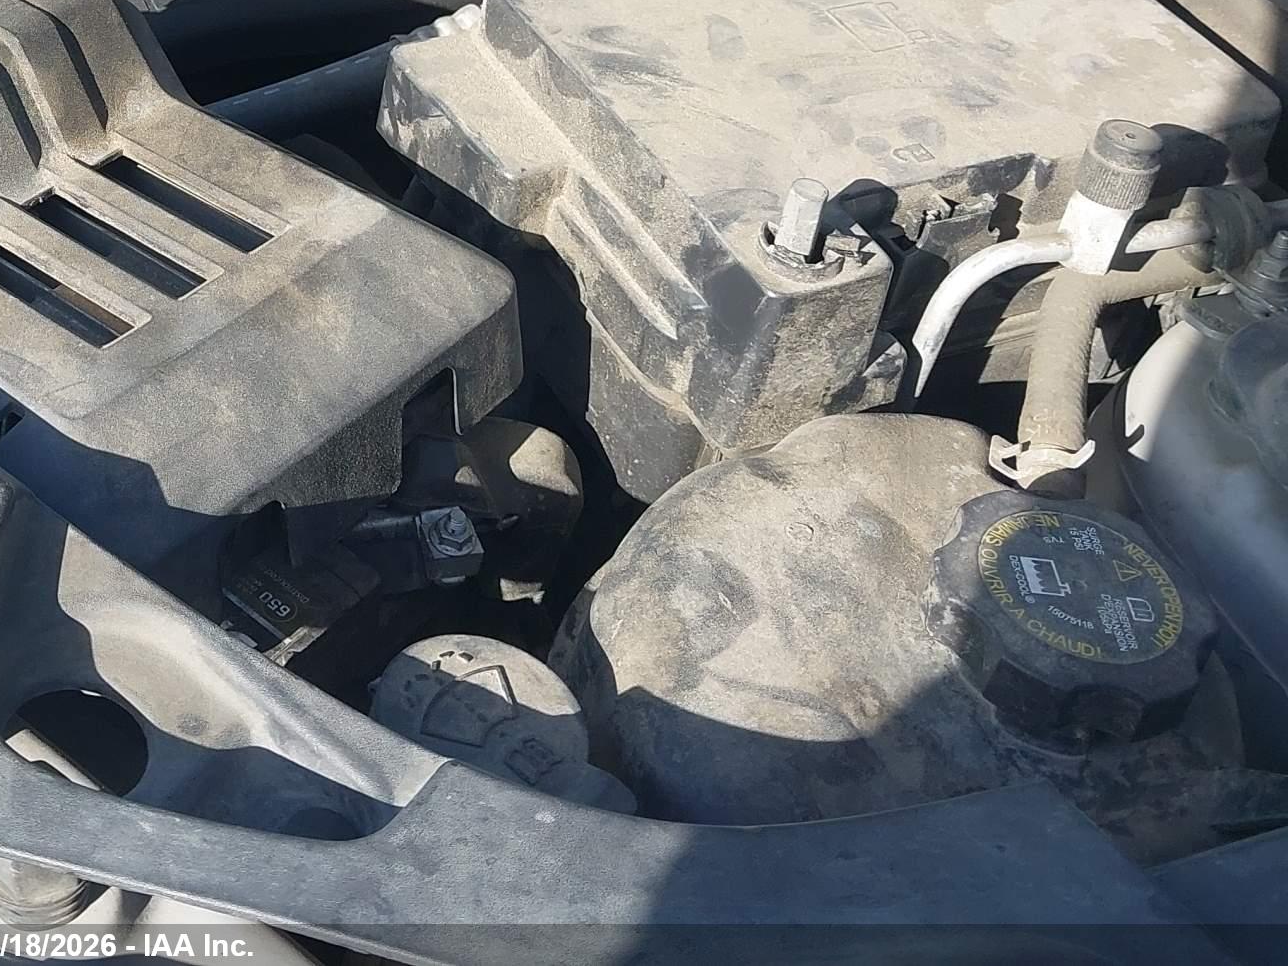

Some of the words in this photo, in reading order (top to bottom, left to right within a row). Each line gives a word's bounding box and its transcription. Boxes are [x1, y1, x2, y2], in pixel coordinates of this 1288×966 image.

[986, 515, 1031, 547] JAMAIS
[1033, 515, 1061, 527] NE
[1078, 529, 1094, 551] TANK
[1086, 526, 1105, 556] SURGE
[981, 548, 1014, 604] OUVRIR
[1123, 543, 1170, 586] NEVER
[259, 591, 291, 617] 650
[1027, 619, 1103, 658] CHAUD!
